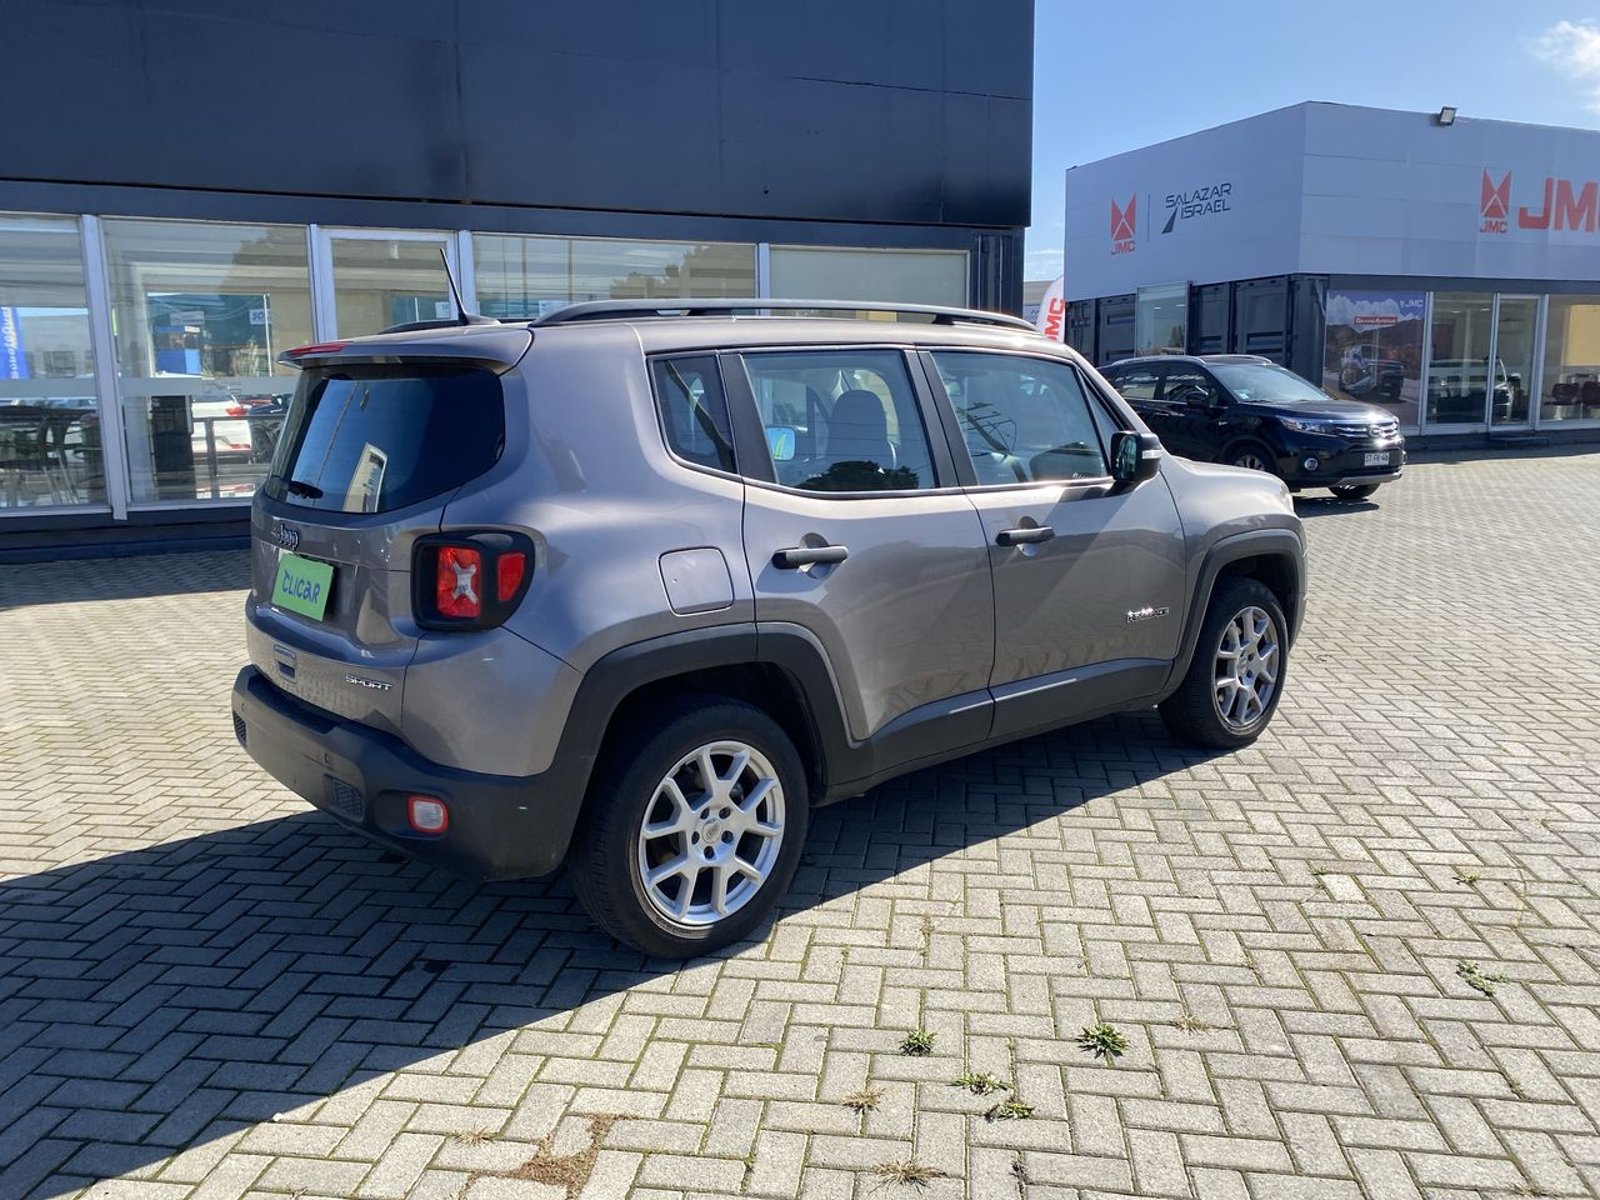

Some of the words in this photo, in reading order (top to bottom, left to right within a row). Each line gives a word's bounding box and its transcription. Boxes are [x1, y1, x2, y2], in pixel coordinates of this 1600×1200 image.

[1165, 182, 1232, 208] SALAZAR
[1180, 199, 1231, 219] ISRAEL
[1518, 177, 1600, 232] JM
[1479, 220, 1508, 233] JMC
[1110, 240, 1136, 255] JMC
[345, 673, 393, 690] SPORT
